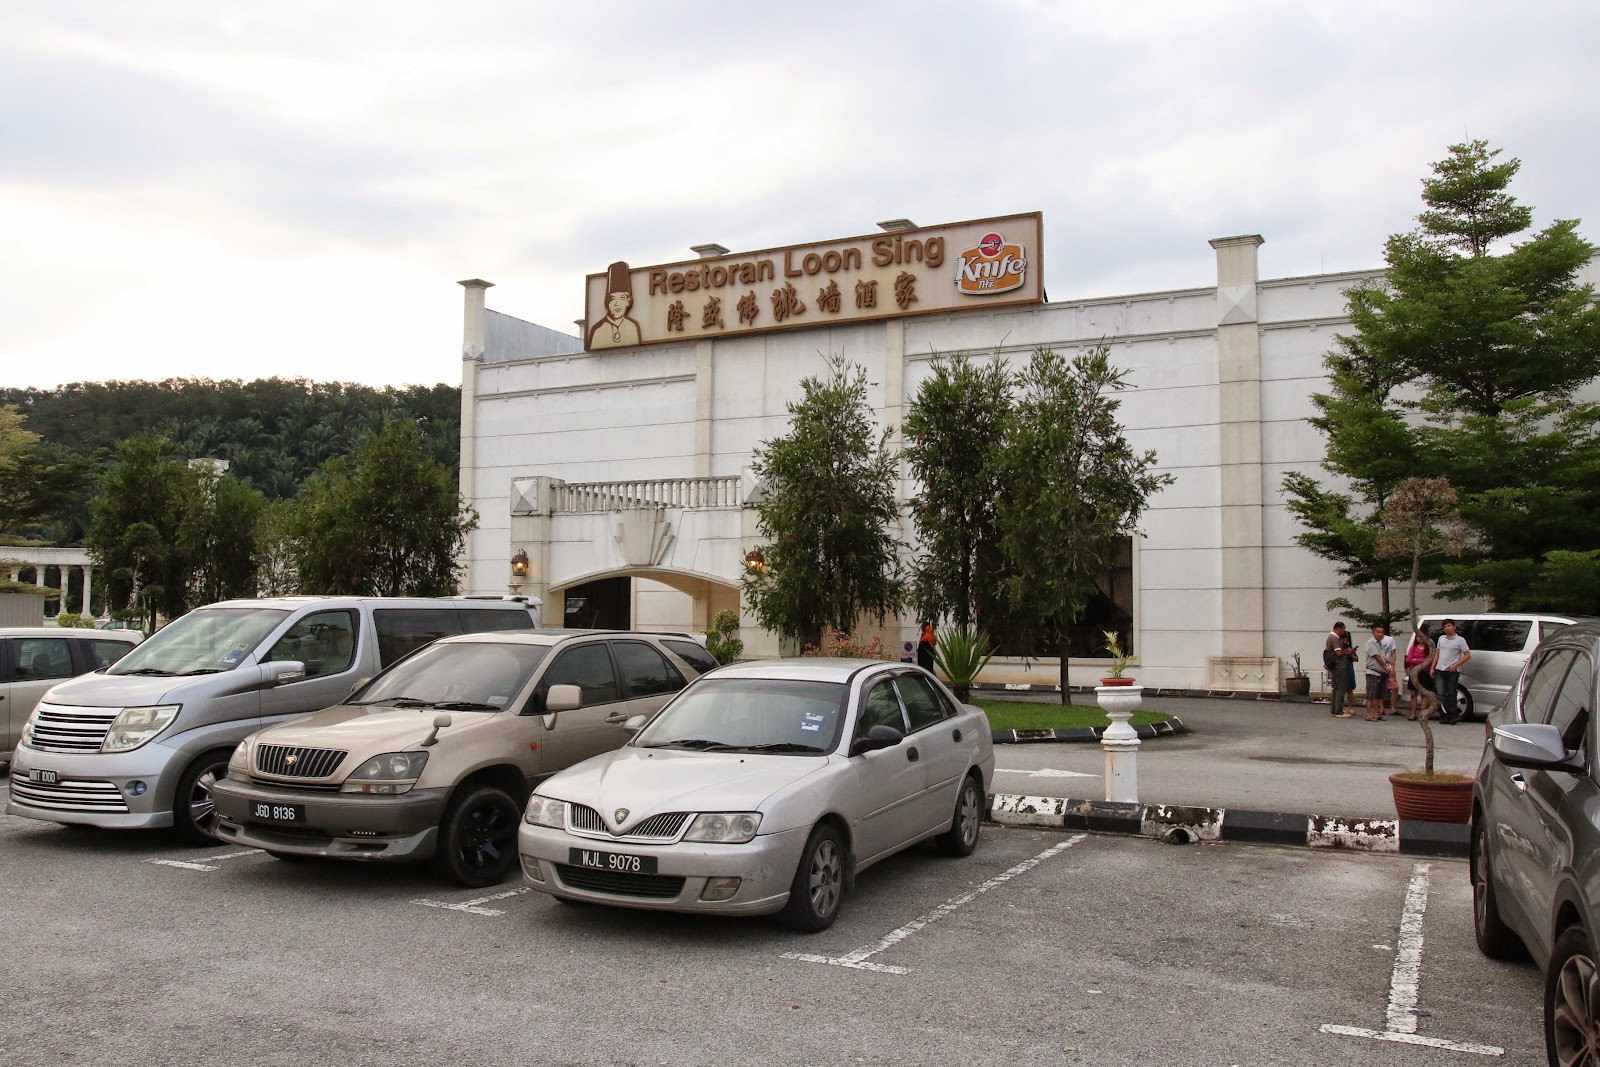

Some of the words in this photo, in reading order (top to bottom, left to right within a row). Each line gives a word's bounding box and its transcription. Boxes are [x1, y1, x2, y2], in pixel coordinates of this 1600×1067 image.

[649, 259, 774, 296] Restoran
[784, 247, 861, 277] Loon
[872, 236, 944, 267] Sing
[954, 254, 1026, 282] Knife
[255, 804, 270, 818] JGD
[273, 806, 295, 820] 8136
[582, 850, 604, 868] WJL
[608, 854, 640, 871] 9078
